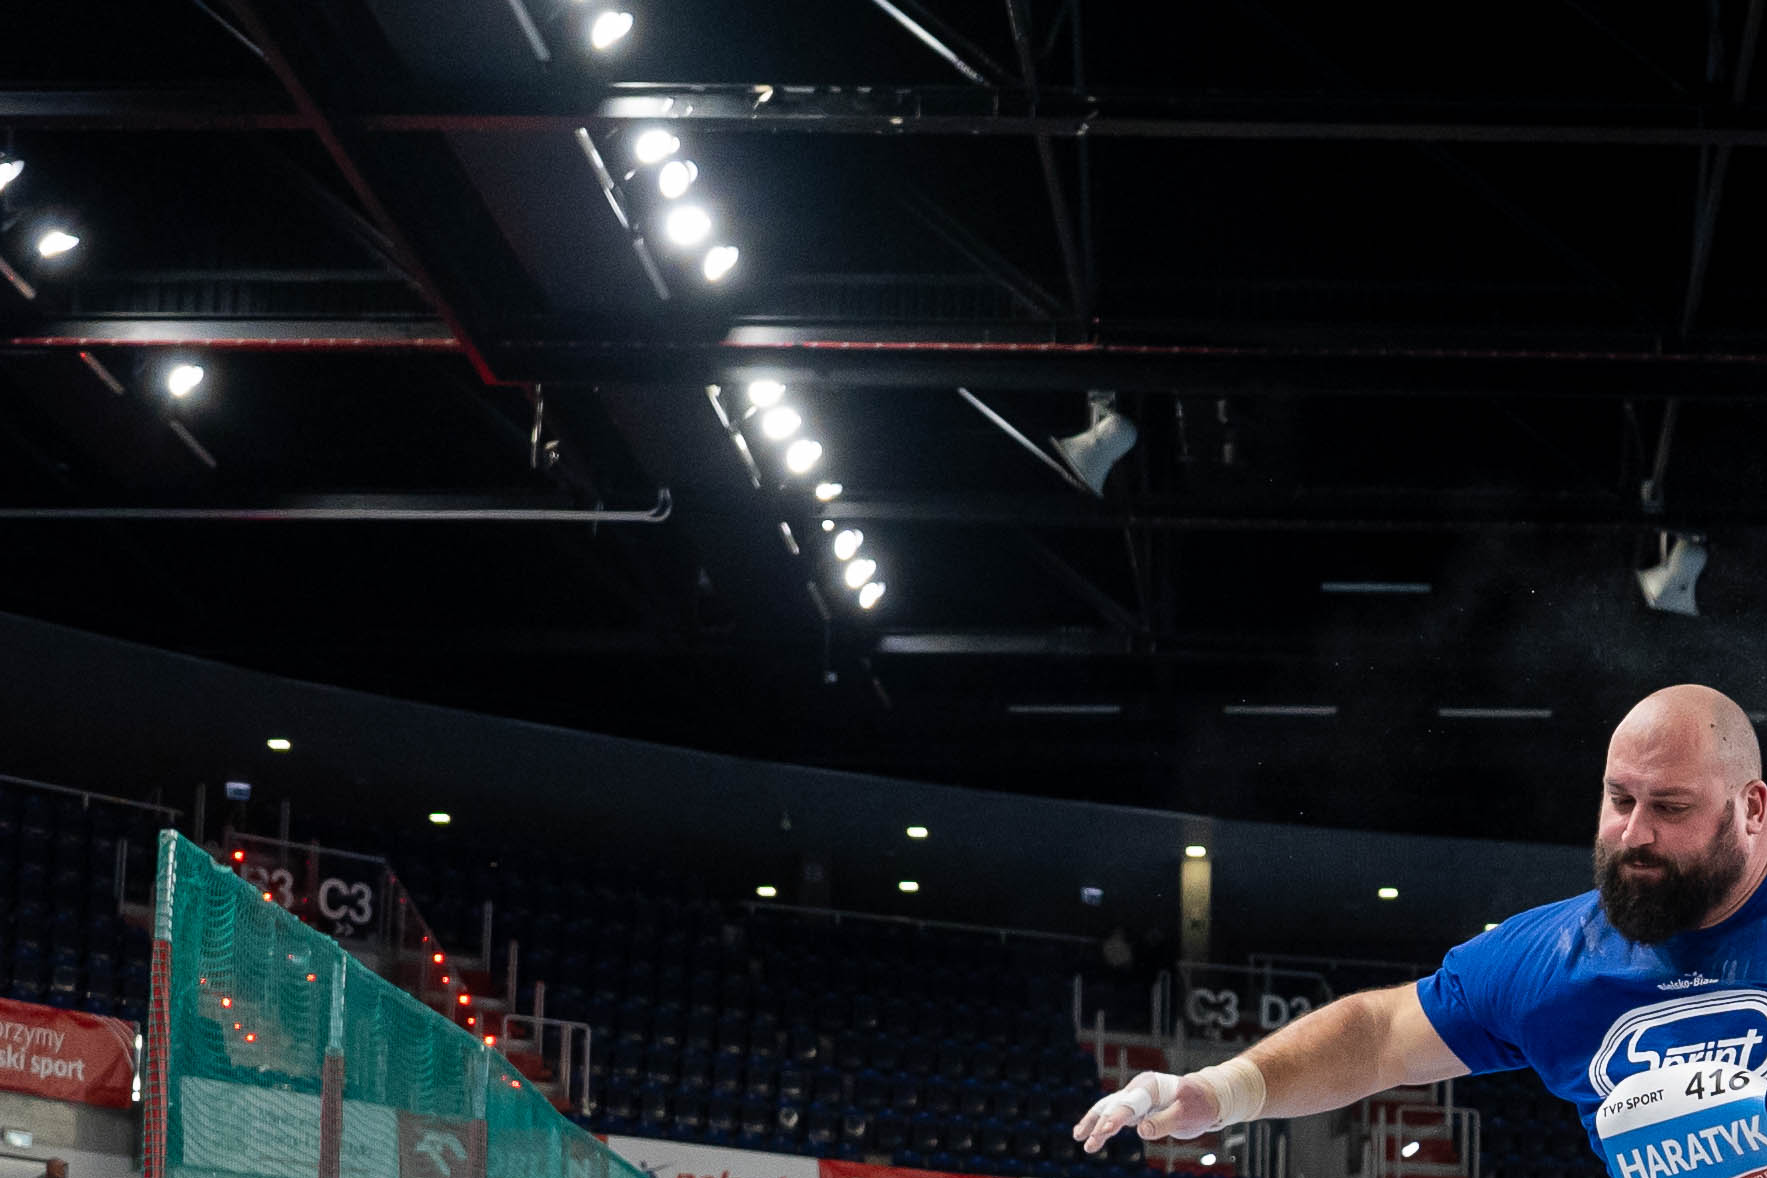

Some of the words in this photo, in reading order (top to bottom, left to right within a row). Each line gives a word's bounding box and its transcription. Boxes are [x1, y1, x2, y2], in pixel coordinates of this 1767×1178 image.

[319, 878, 372, 924] C3
[1187, 987, 1240, 1029] C3
[0, 1021, 65, 1052] rzymy
[30, 1055, 85, 1081] sport
[1602, 1101, 1624, 1118] TVP
[1626, 1089, 1665, 1111] SPORT
[1685, 1068, 1750, 1101] 416
